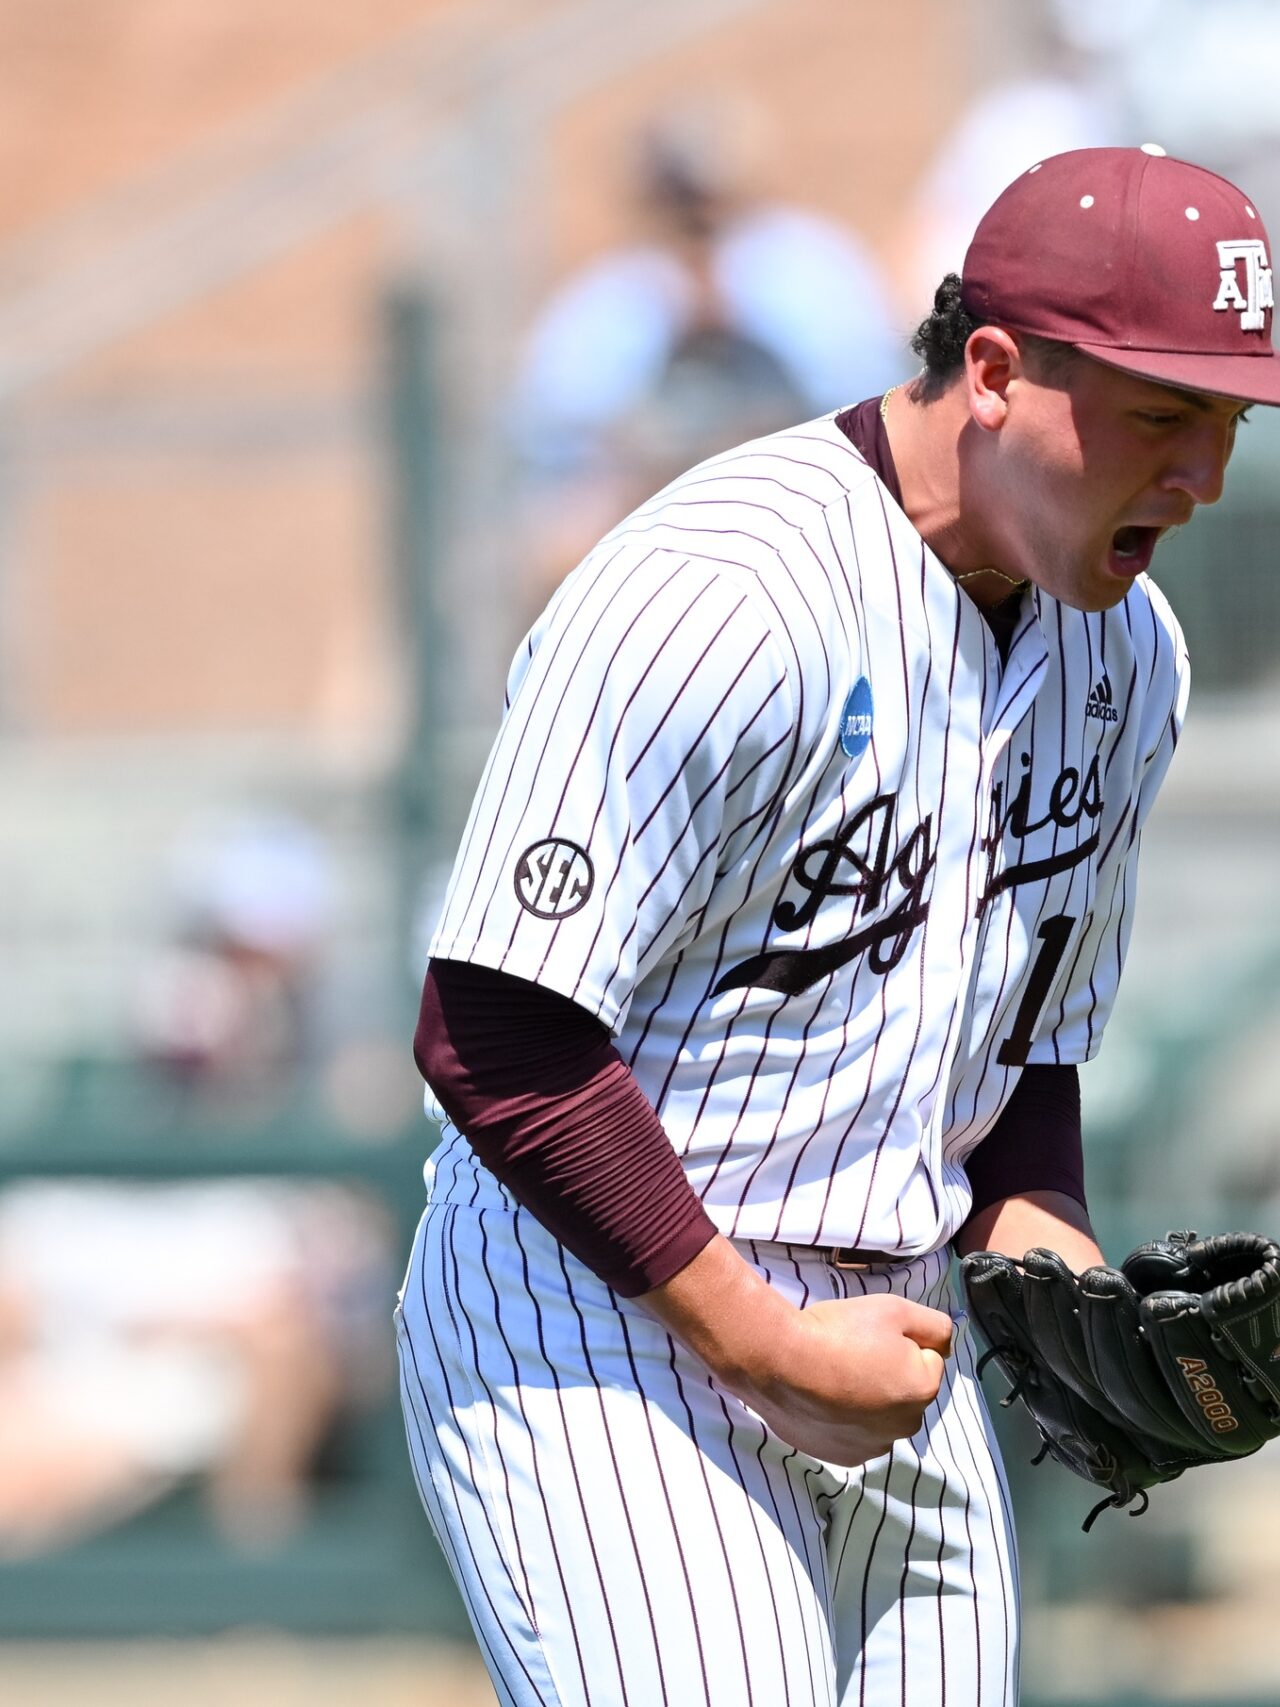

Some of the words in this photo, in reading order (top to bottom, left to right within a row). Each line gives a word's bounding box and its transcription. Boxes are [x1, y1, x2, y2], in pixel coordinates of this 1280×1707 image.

[844, 715, 872, 736] NCAA
[519, 842, 590, 914] SEC
[1176, 1356, 1239, 1434] A2000
